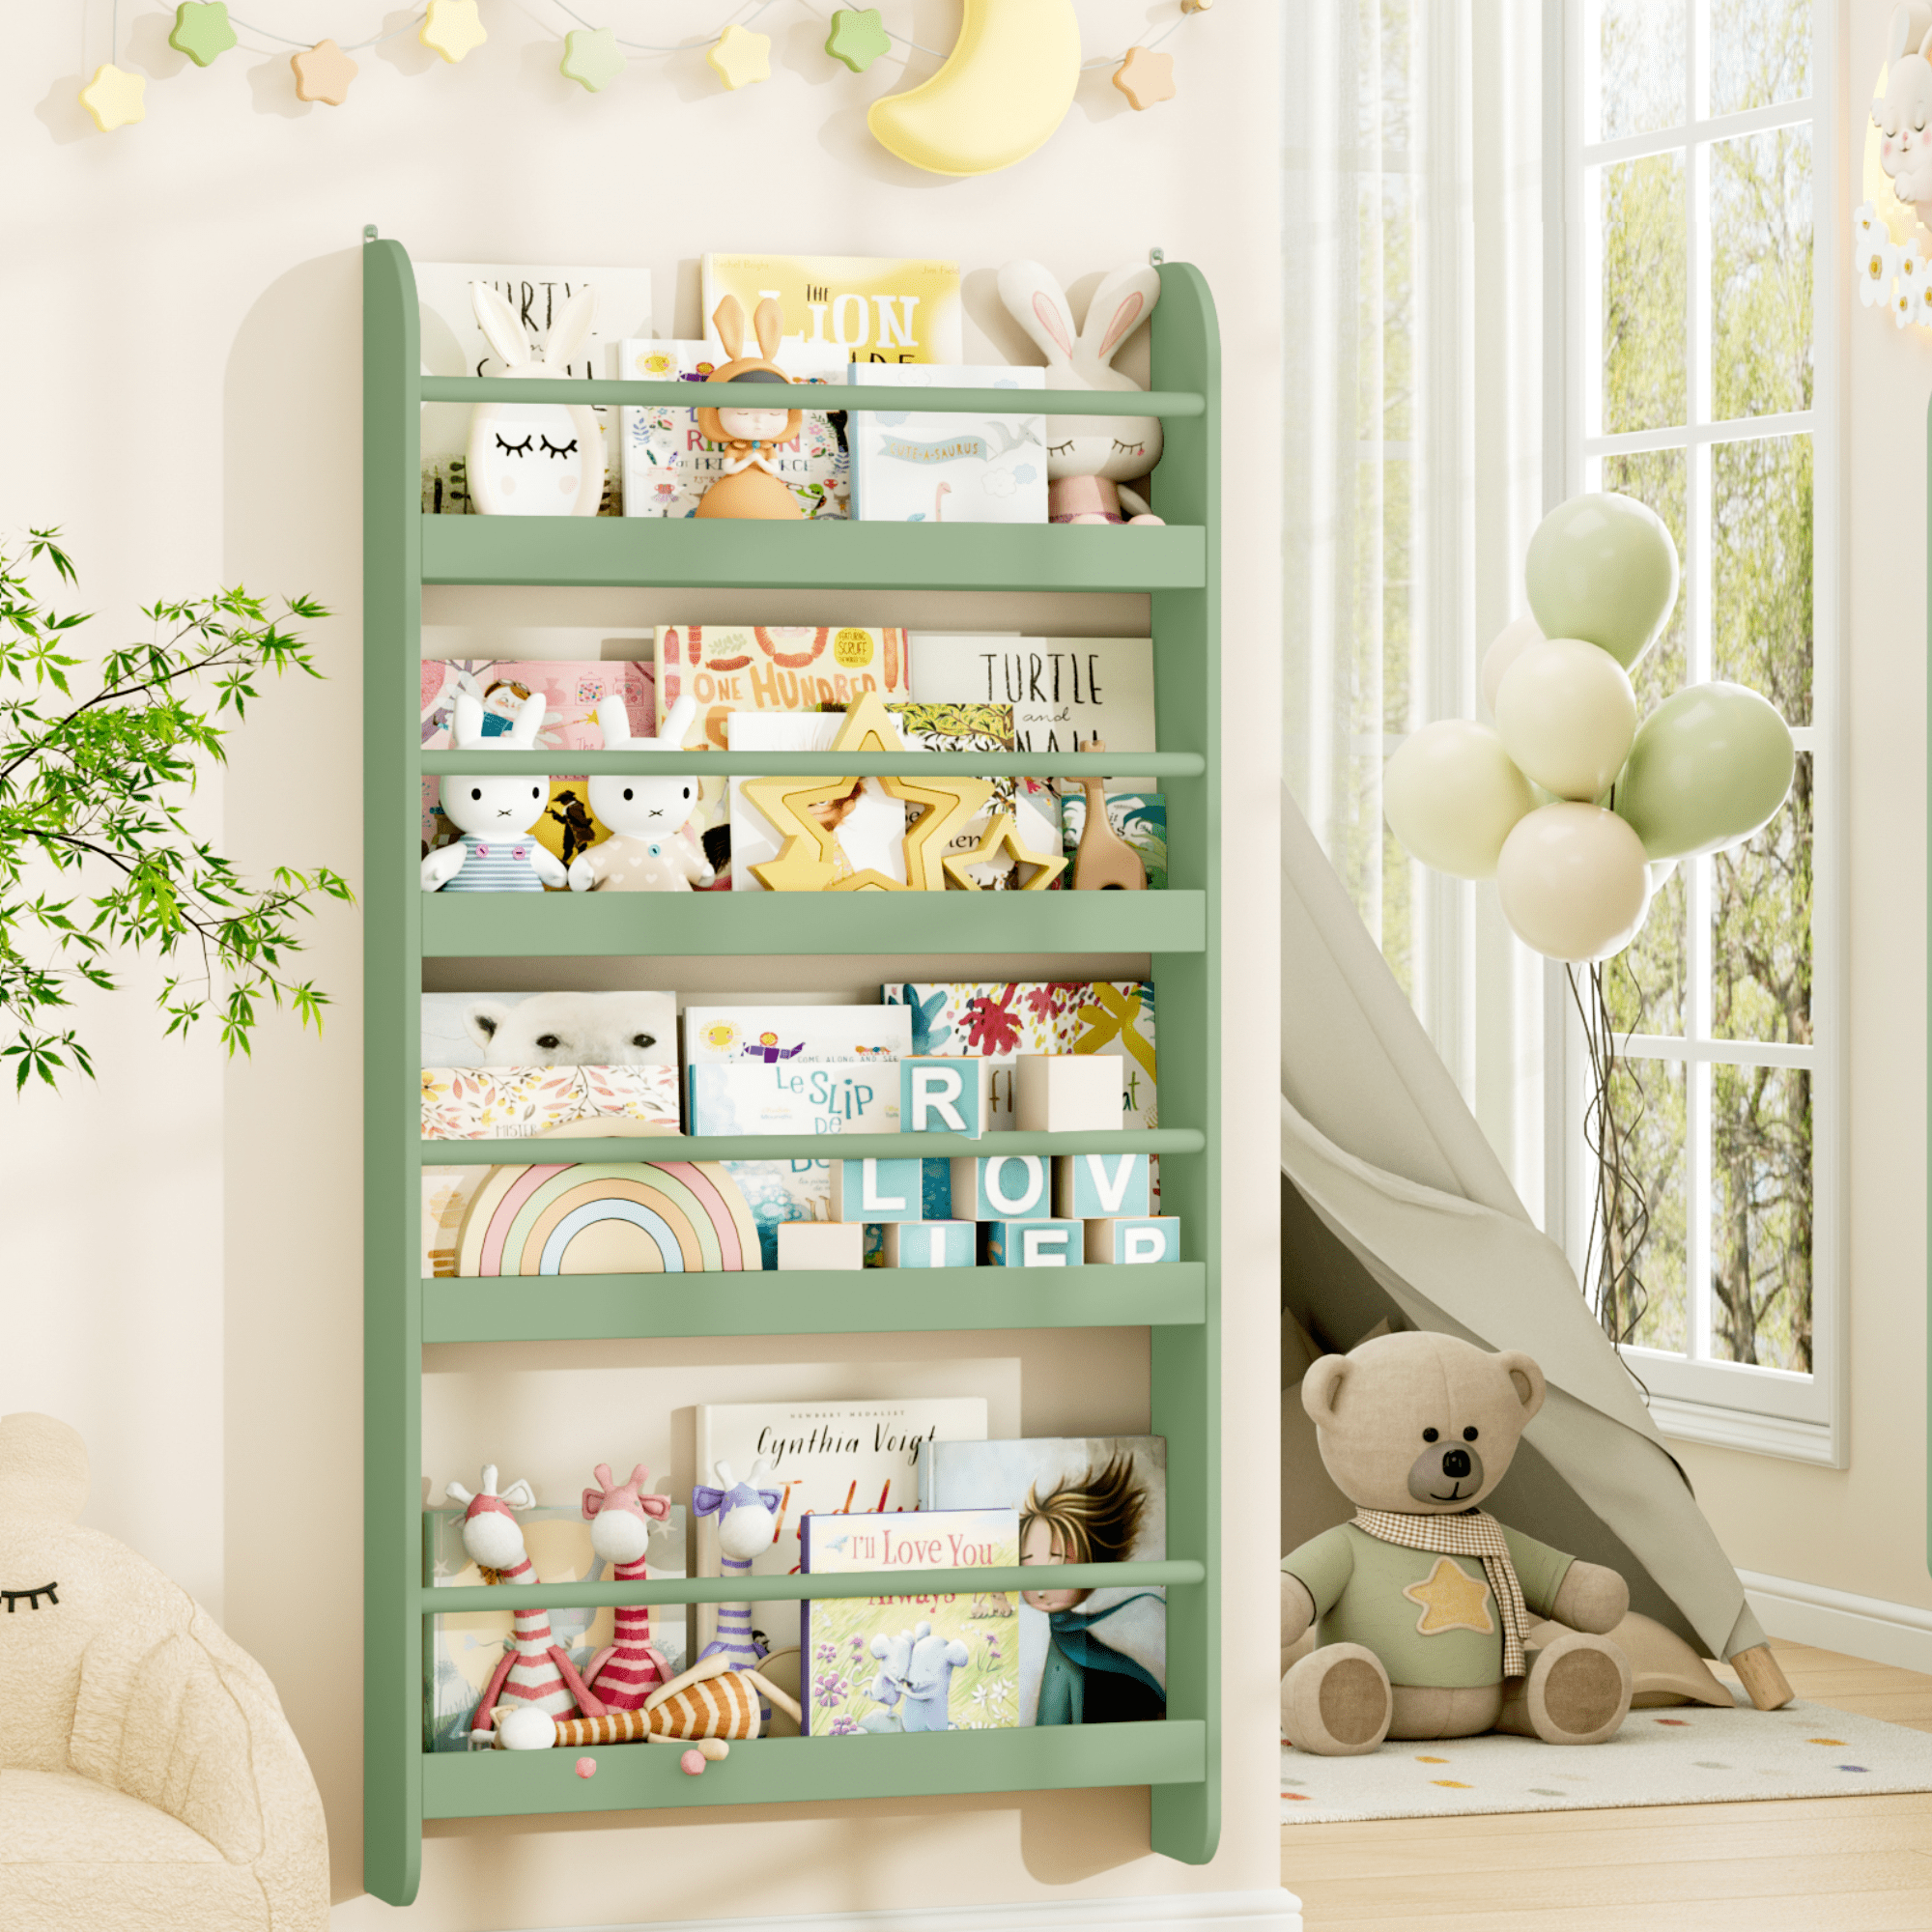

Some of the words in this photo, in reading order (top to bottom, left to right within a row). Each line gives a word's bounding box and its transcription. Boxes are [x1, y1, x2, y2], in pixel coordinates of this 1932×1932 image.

[806, 284, 832, 302] THE
[890, 442, 979, 461] CUTE-A-SAURUS
[693, 672, 744, 704] ONE
[750, 661, 877, 709] HUNDRED
[979, 653, 1103, 705] TURTLE
[1022, 706, 1071, 723] and
[776, 1065, 804, 1094] Le
[911, 1066, 967, 1131] R
[984, 1156, 1044, 1215] O
[1085, 1154, 1137, 1212] V
[757, 1424, 860, 1470] Cynthia
[874, 1422, 936, 1466] Voigt
[853, 1536, 875, 1559] I'll
[882, 1529, 942, 1565] Love
[948, 1534, 993, 1567] You
